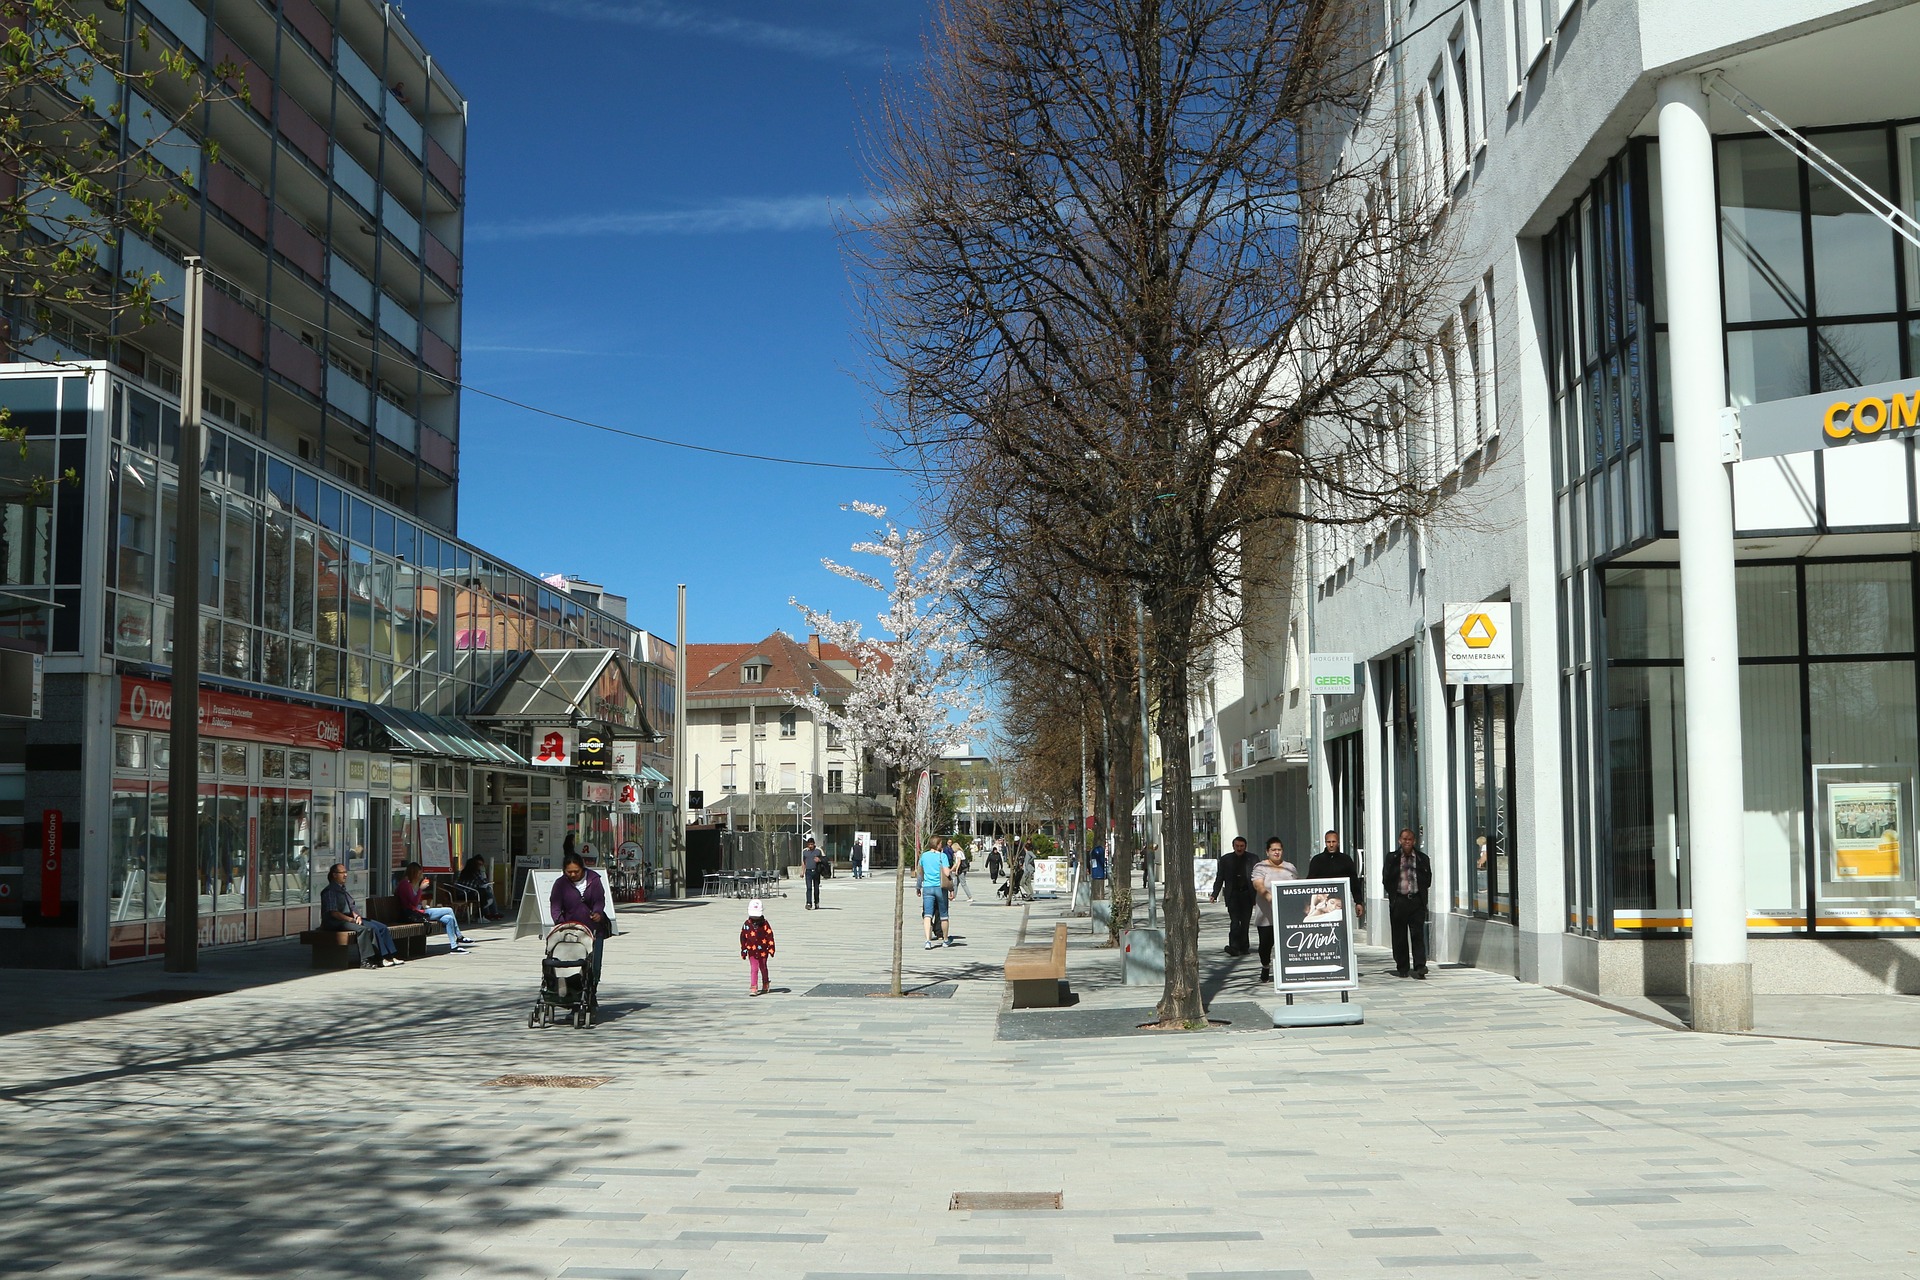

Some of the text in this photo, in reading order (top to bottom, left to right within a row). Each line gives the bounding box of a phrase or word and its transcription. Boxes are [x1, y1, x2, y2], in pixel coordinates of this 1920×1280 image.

[1451, 653, 1506, 661] COMMERZBANK
[1314, 676, 1351, 685] GEERS
[48, 813, 56, 857] vodafone
[1283, 887, 1338, 895] MASSAGEPRAXIS
[1287, 928, 1336, 952] Minh
